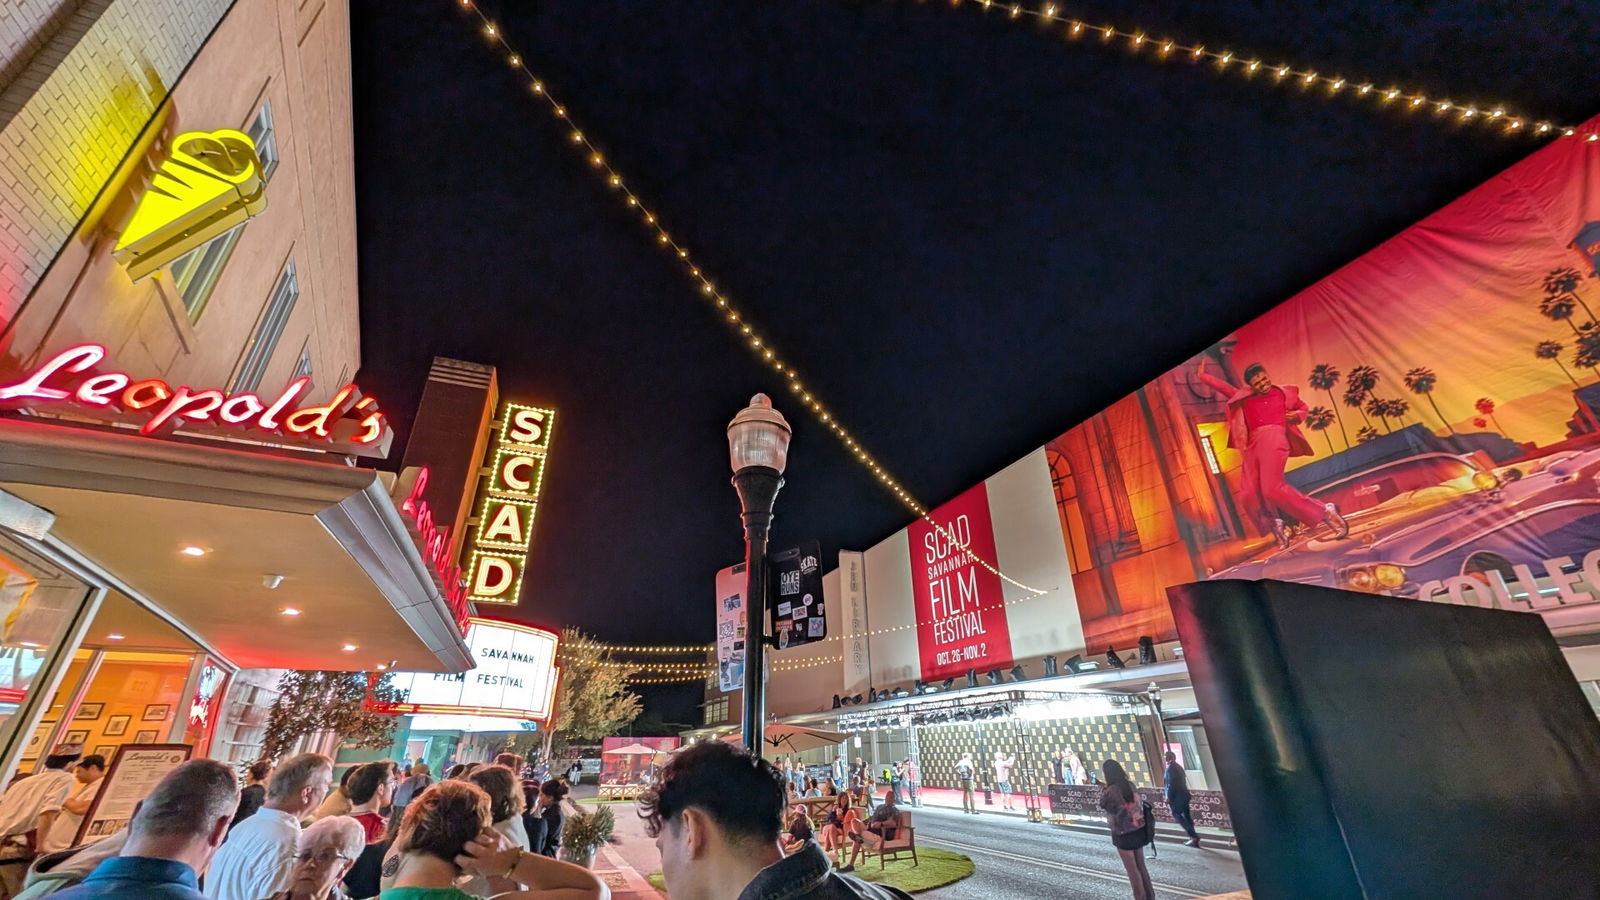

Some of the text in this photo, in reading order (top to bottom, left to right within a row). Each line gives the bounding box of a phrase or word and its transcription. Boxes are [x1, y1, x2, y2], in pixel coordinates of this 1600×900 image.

[0, 344, 384, 444] Leopold's
[474, 410, 545, 596] SCAD
[924, 514, 971, 564] SCAD
[800, 555, 818, 572] SKATE
[927, 551, 975, 580] SAVANNAH
[781, 581, 799, 594] RUNS
[929, 565, 980, 620] FILM
[933, 610, 987, 646] FESTIVAL
[481, 647, 534, 664] SAVANNAH
[936, 652, 951, 666] OCT.
[981, 643, 987, 657] 2
[433, 672, 523, 689] FILM FESTIVAL
[1189, 803, 1210, 812] SCAD
[1200, 796, 1221, 805] SCAD
[1201, 812, 1223, 820] SCAD
